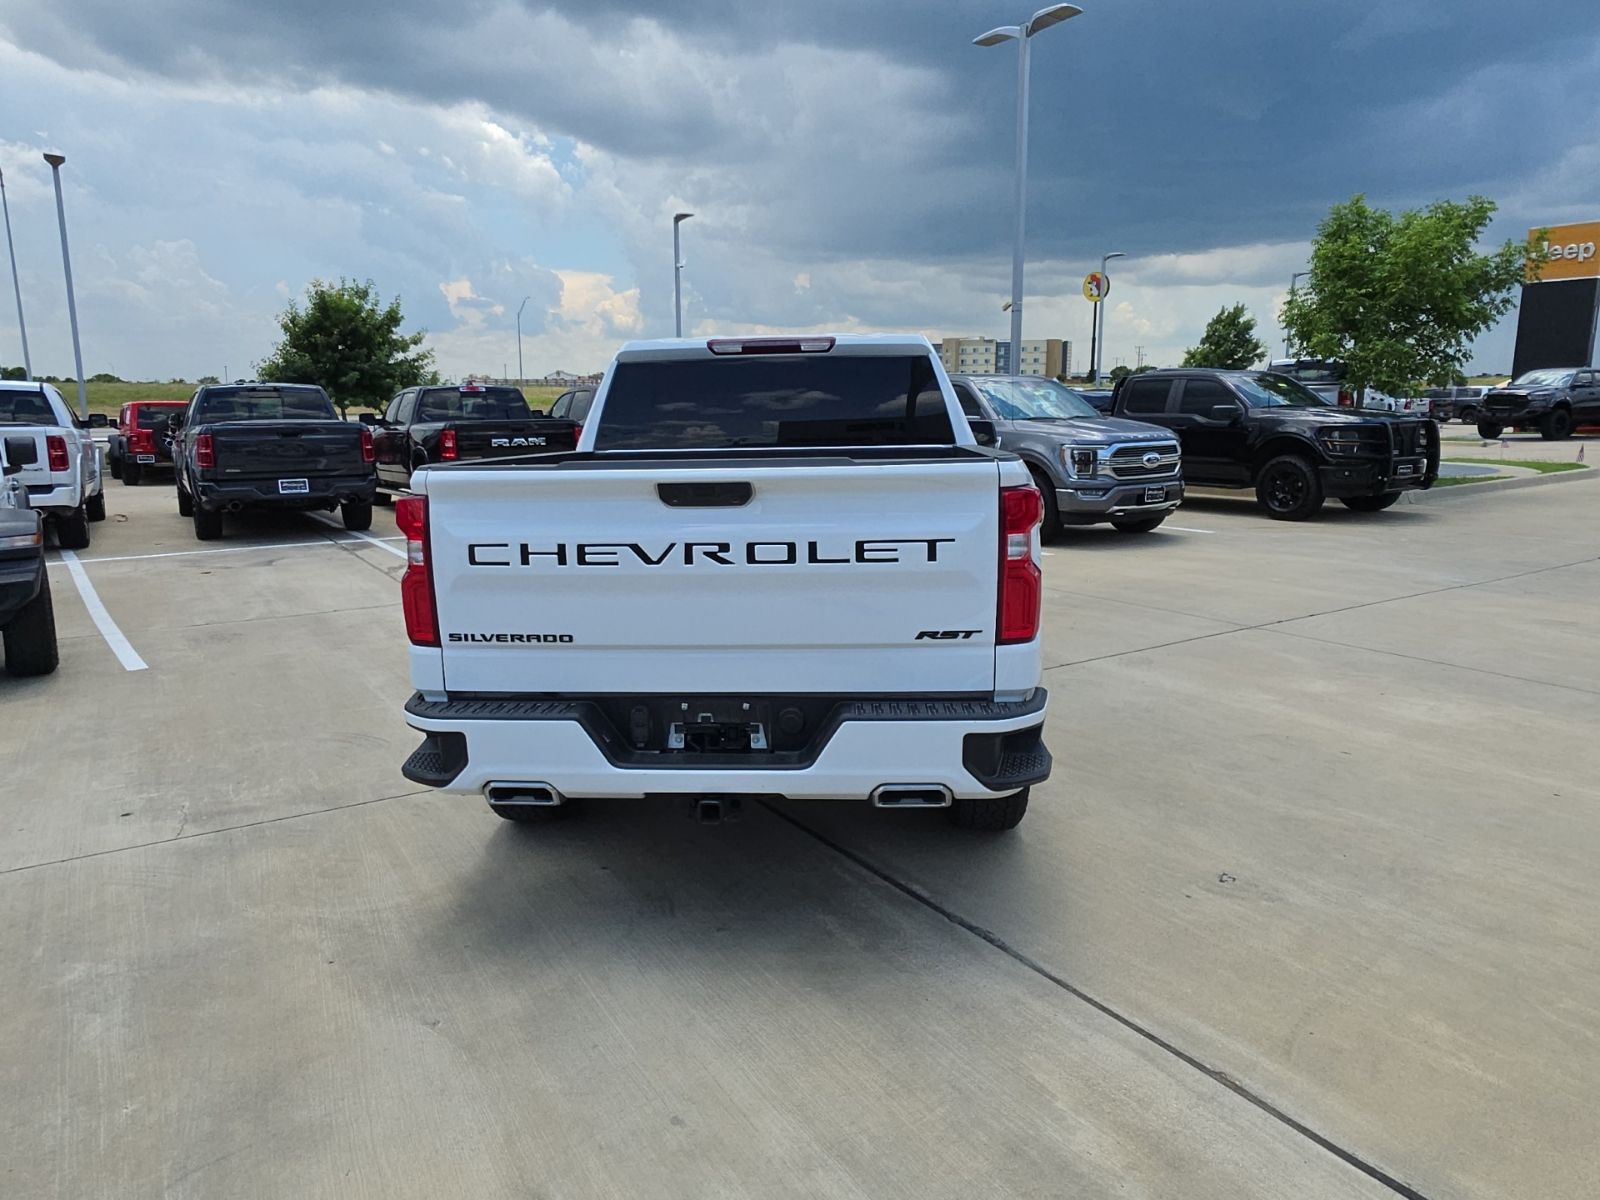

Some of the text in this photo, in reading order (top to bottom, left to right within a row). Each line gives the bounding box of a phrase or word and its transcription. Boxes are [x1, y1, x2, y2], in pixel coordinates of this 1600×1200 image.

[491, 436, 547, 447] RAM
[468, 537, 956, 568] CHEVROLET
[449, 632, 574, 643] SILVERADO
[914, 629, 983, 640] RST
